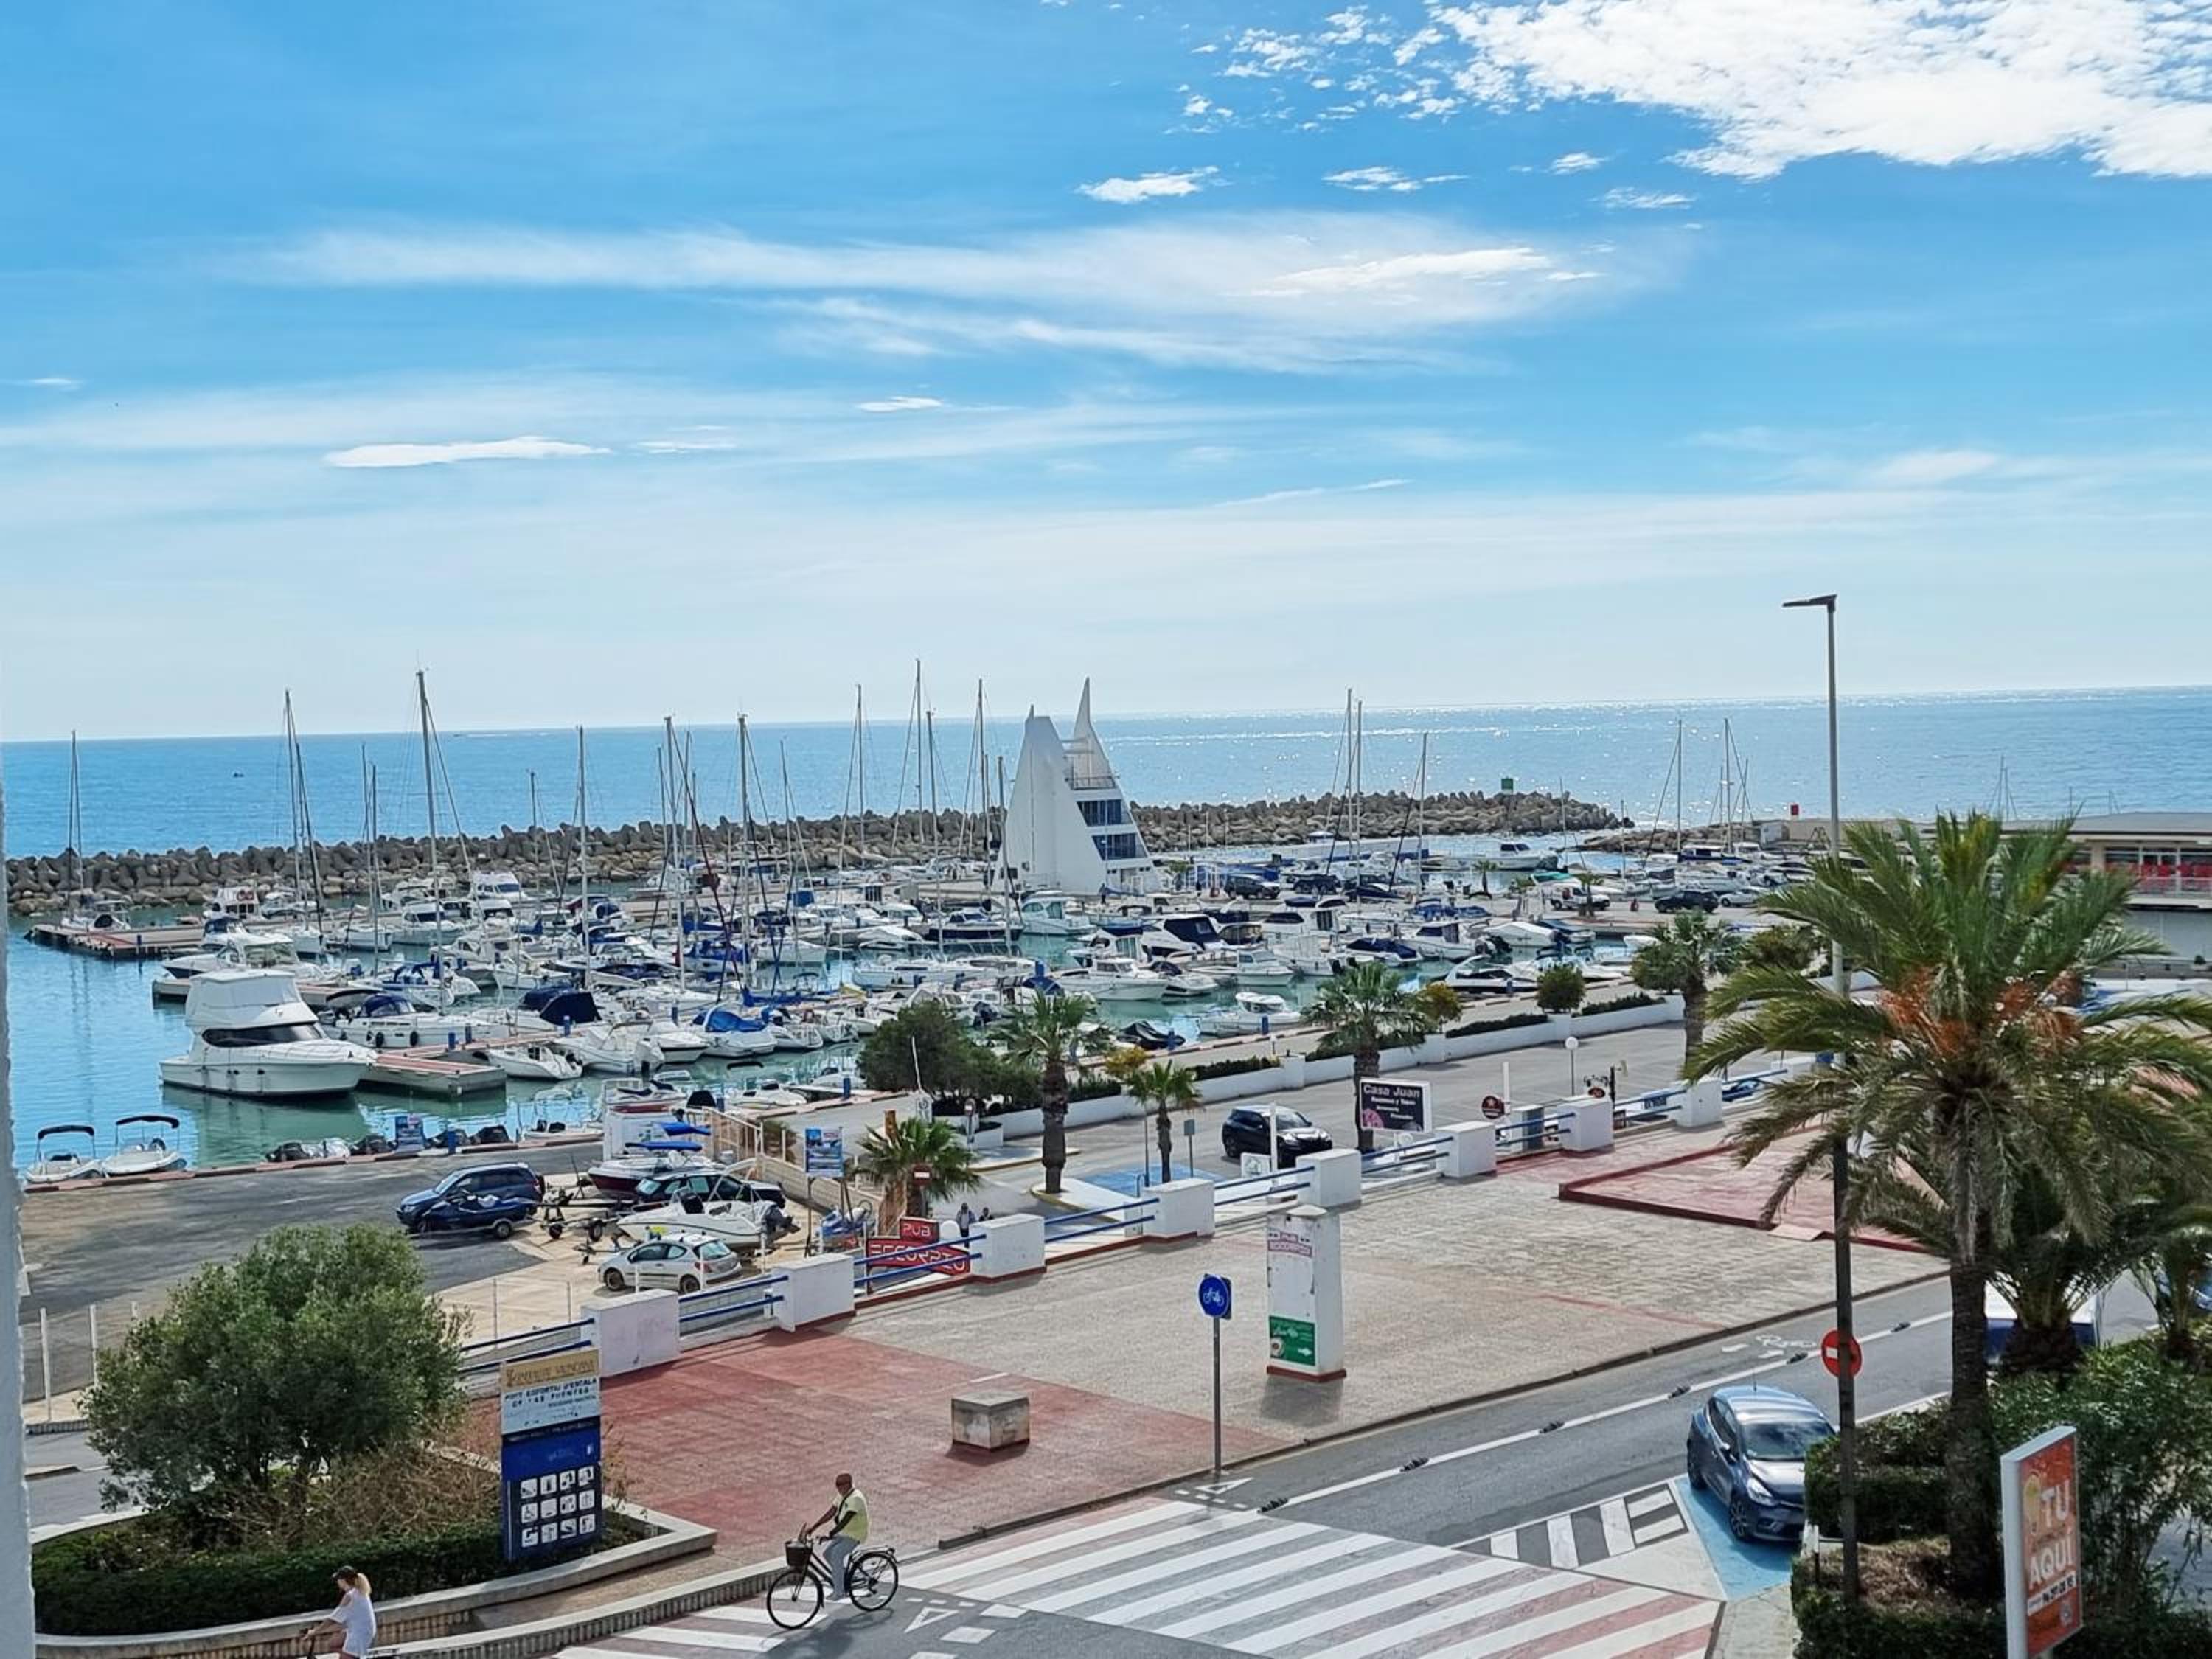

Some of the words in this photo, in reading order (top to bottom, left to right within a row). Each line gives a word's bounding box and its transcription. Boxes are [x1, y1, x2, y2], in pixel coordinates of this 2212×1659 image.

[1363, 1085, 1390, 1096] Casa
[1393, 1087, 1420, 1097] Juan
[902, 1223, 931, 1237] PUB
[2041, 1480, 2070, 1528] TU
